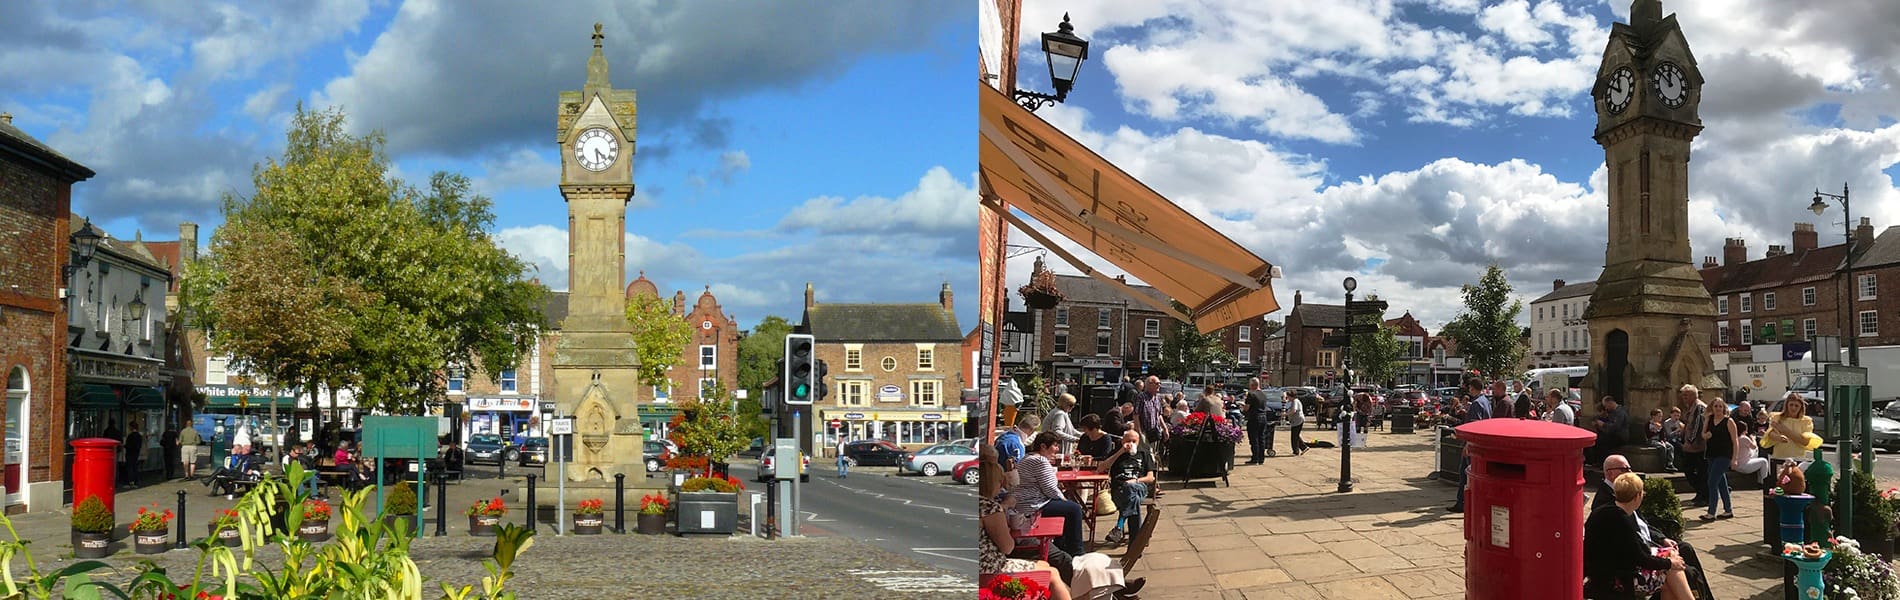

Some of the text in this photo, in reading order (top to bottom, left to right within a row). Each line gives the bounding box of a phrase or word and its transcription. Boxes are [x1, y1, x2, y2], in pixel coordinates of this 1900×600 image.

[1747, 365, 1767, 373] CARL'S
[195, 386, 226, 397] White
[253, 387, 282, 397] Boos
